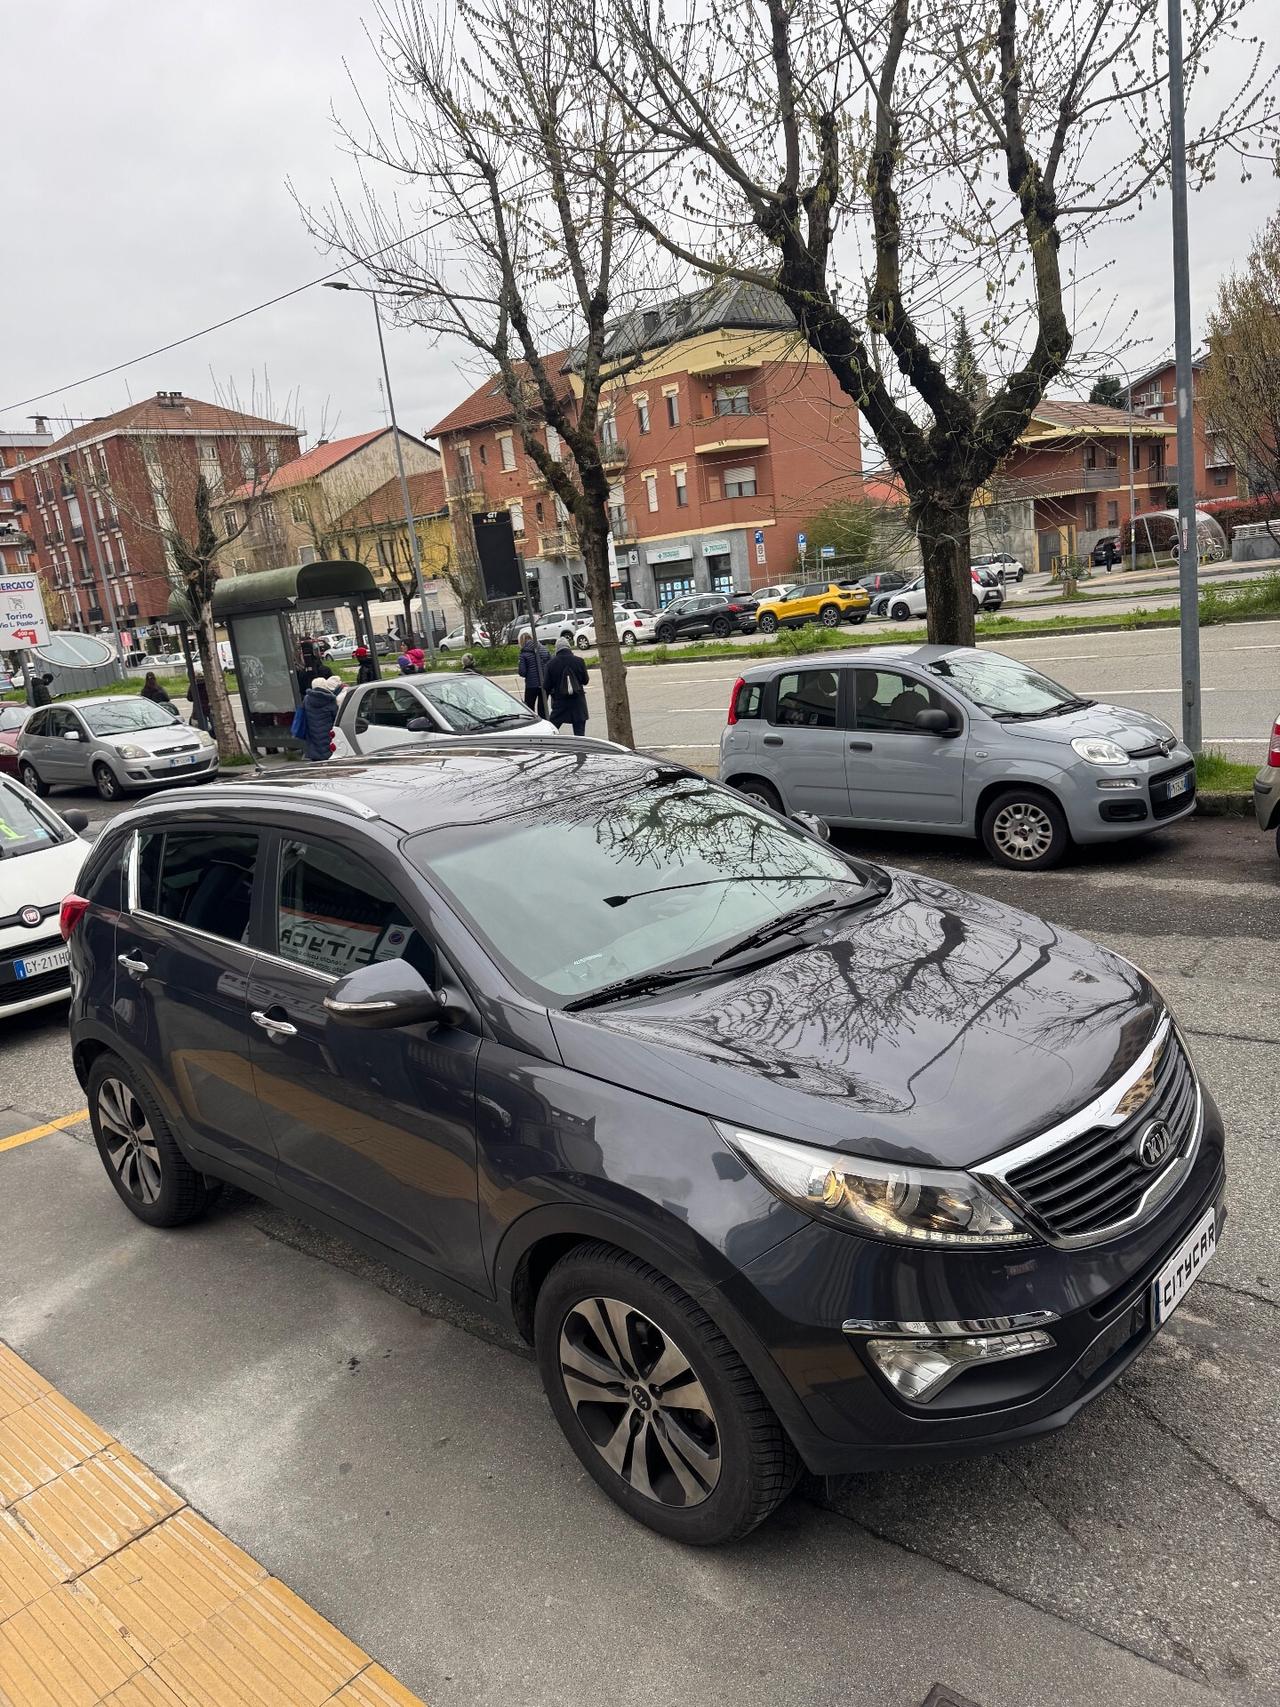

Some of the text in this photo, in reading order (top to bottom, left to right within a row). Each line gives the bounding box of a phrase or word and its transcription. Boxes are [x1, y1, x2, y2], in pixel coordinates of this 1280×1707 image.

[0, 580, 34, 591] ERCATO'
[6, 612, 33, 621] Torino
[1145, 1126, 1171, 1163] KIA
[1163, 1222, 1215, 1308] CITYCAR
[633, 1388, 648, 1409] KIA
